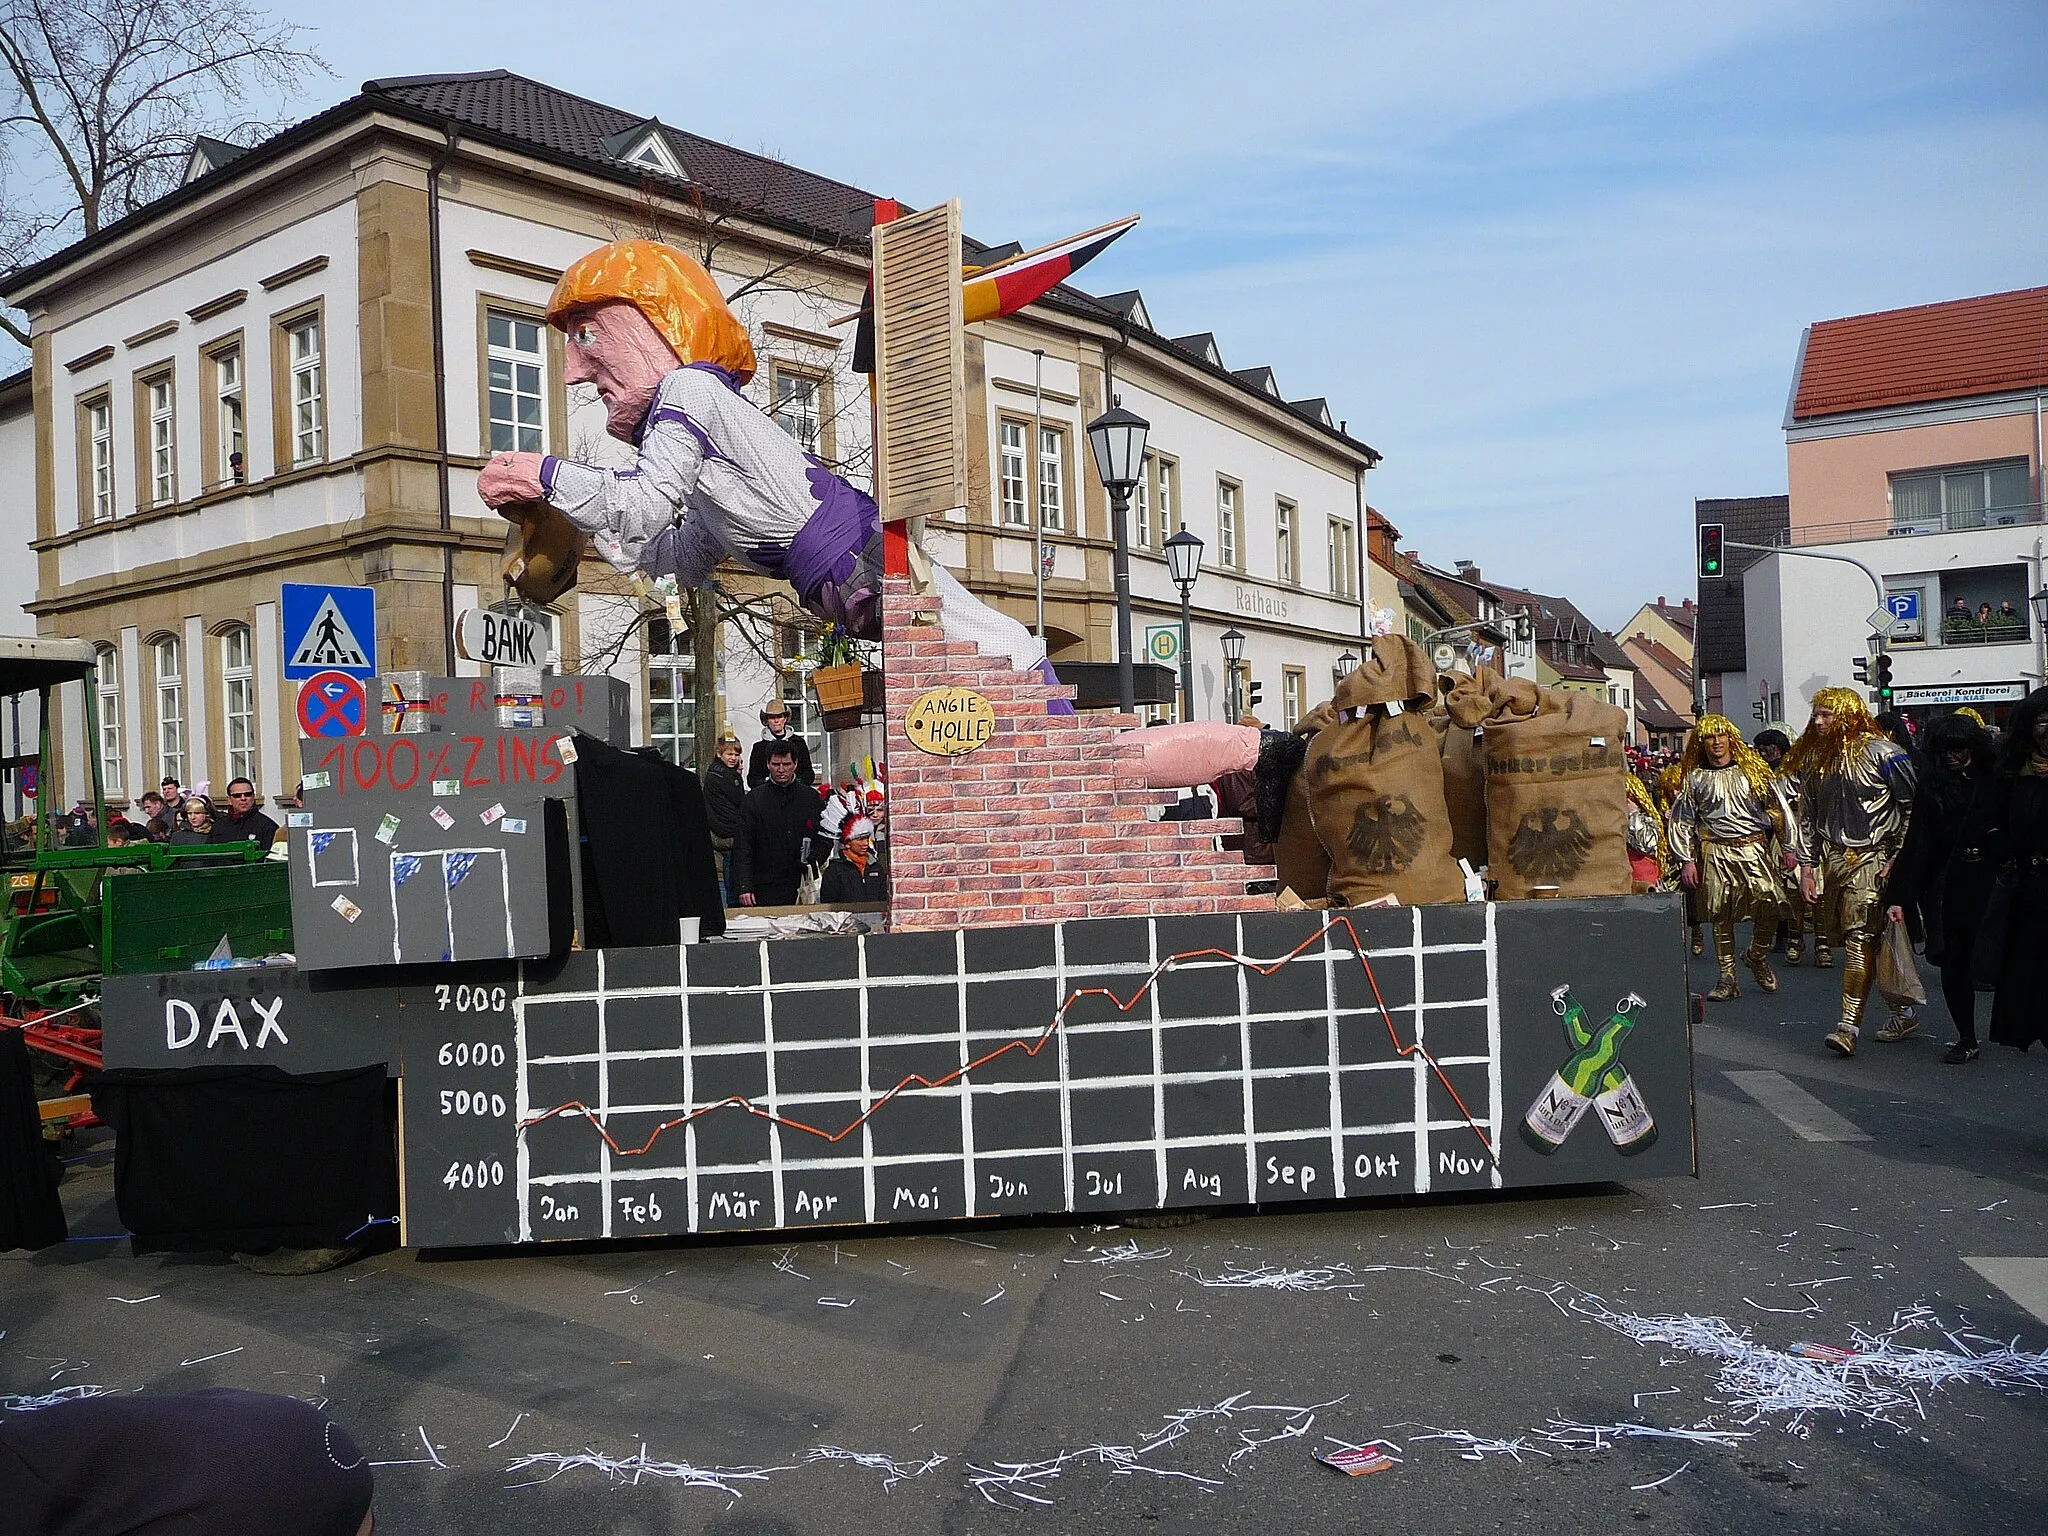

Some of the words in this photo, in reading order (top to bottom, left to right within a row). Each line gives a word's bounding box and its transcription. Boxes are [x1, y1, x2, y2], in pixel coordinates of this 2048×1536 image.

[1235, 586, 1287, 618] Rathaus
[1895, 601, 1909, 619] P
[482, 614, 536, 665] BANK
[1158, 636, 1170, 653] H
[1906, 690, 1951, 698] Bäckerei
[1955, 686, 2010, 696] Konditorei
[922, 697, 977, 715] ANGIE
[931, 719, 988, 742] HOLLE
[318, 739, 451, 796] 100%
[461, 735, 565, 787] ZINS
[434, 984, 506, 1012] 7000
[166, 996, 288, 1050] DAX
[438, 1042, 505, 1067] 6000
[440, 1090, 507, 1117] 5000
[443, 1160, 504, 1190] 4000
[540, 1195, 579, 1221] Jan
[618, 1193, 662, 1222] Feb
[709, 1191, 760, 1219] Mär
[794, 1191, 838, 1219] Apr
[893, 1186, 939, 1210] Mai
[990, 1174, 1028, 1198] Jun
[1086, 1171, 1122, 1196] Jul
[1183, 1168, 1222, 1197] Aug
[1266, 1156, 1316, 1193] Sep
[1355, 1153, 1400, 1178] Okt
[1439, 1150, 1485, 1175] Nov
